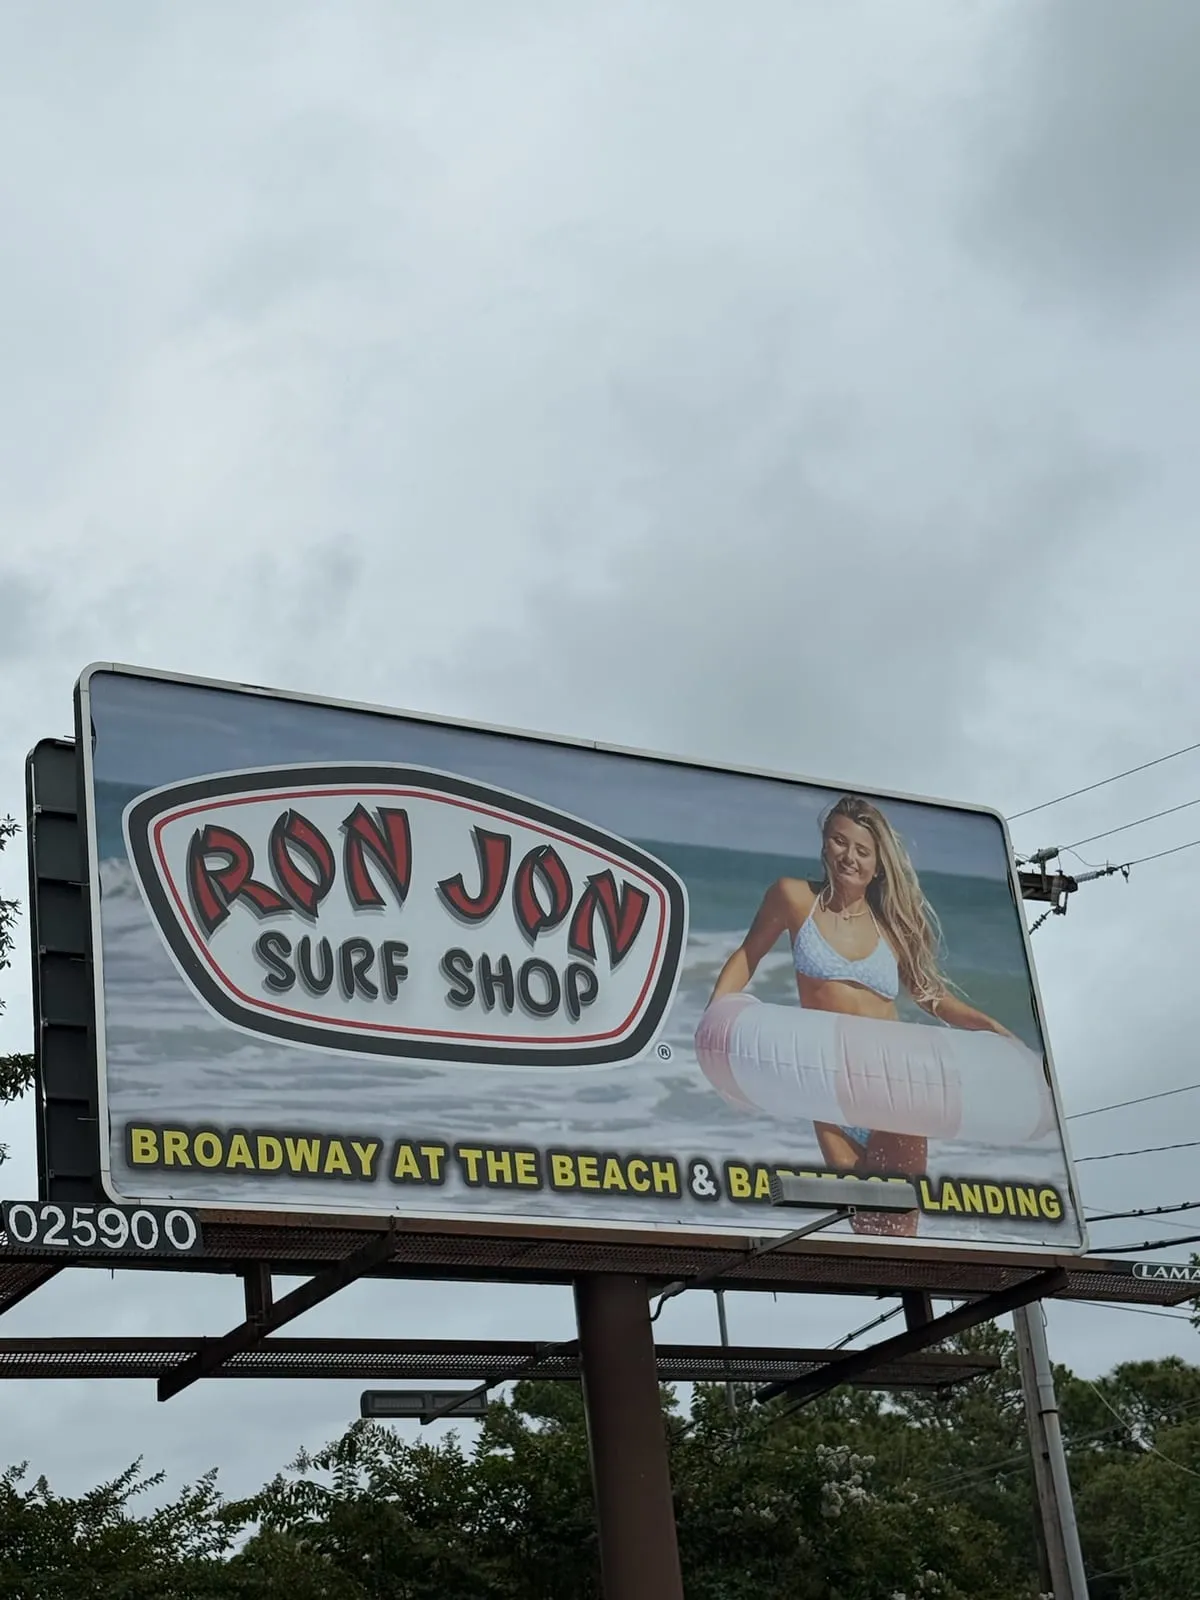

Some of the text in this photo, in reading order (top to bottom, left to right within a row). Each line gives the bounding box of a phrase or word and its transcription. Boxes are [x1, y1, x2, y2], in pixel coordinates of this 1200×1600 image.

[187, 803, 650, 969] RON JON
[253, 931, 599, 1021] SURF SHOP
[131, 1128, 378, 1176] BROADWAY
[394, 1145, 445, 1180] AT
[458, 1148, 538, 1185] THE
[551, 1154, 678, 1194] BEACH
[692, 1164, 716, 1196] &
[920, 1180, 1062, 1219] LANDING
[8, 1204, 197, 1250] 025900
